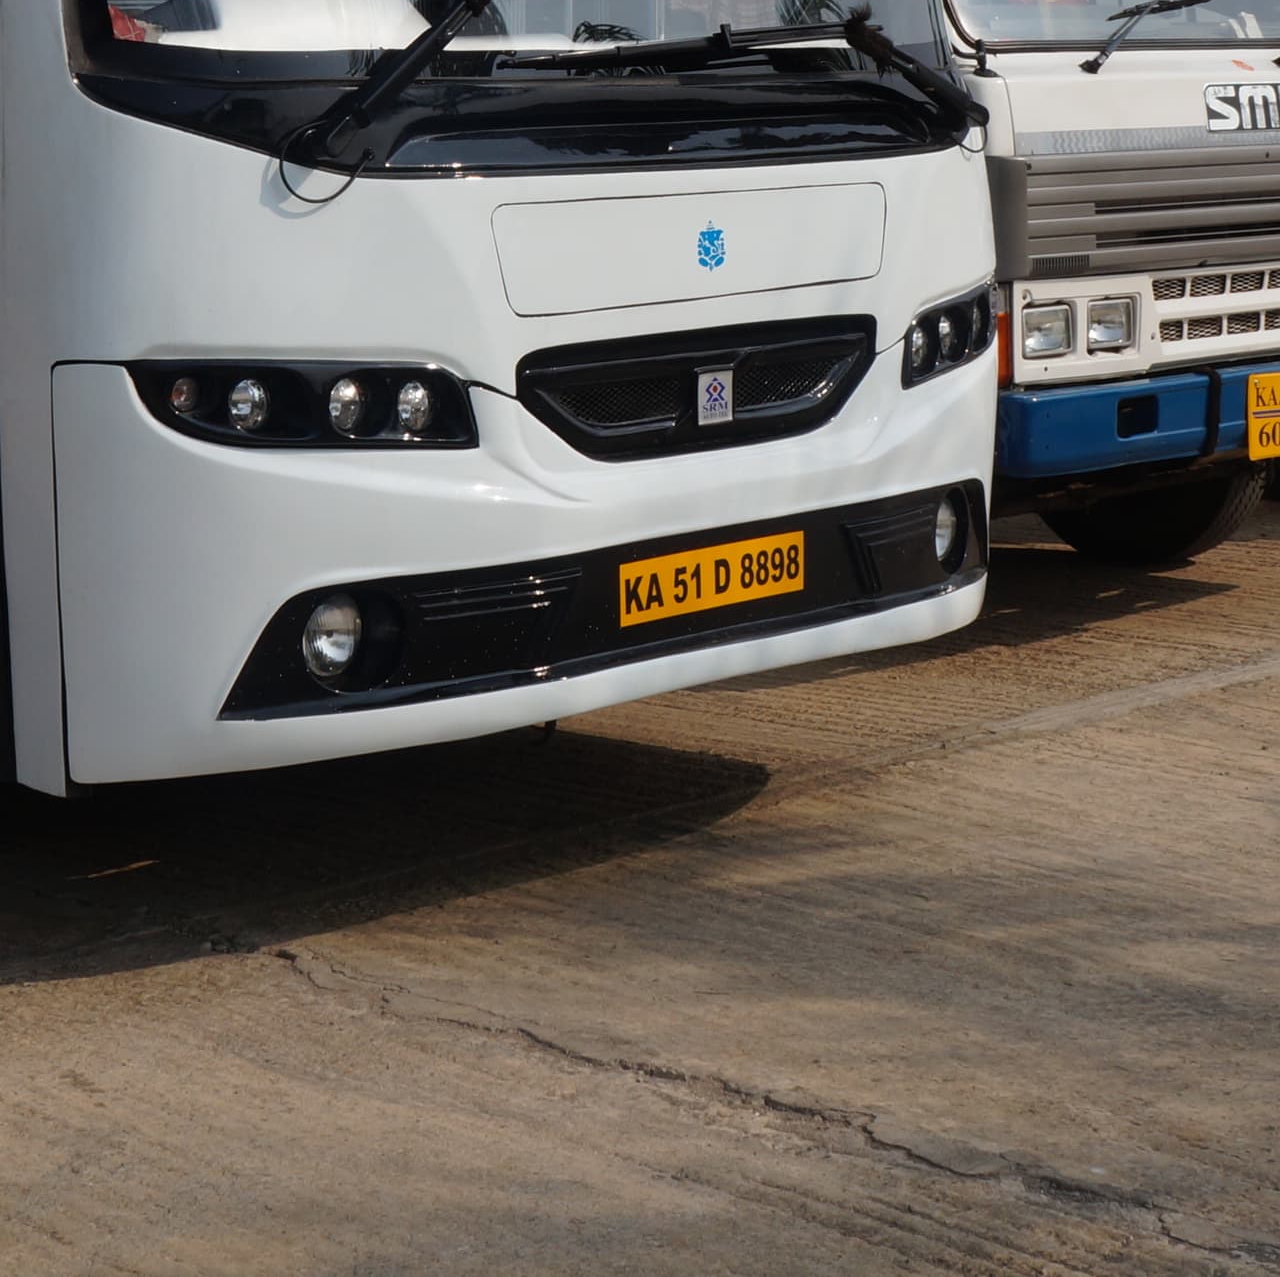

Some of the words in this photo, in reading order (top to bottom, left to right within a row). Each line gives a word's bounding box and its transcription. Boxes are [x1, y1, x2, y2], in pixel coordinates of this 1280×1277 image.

[703, 402, 728, 412] SRM
[625, 573, 665, 615] KA
[673, 563, 702, 604] 51
[714, 559, 731, 594] D
[740, 544, 801, 589] 8898
